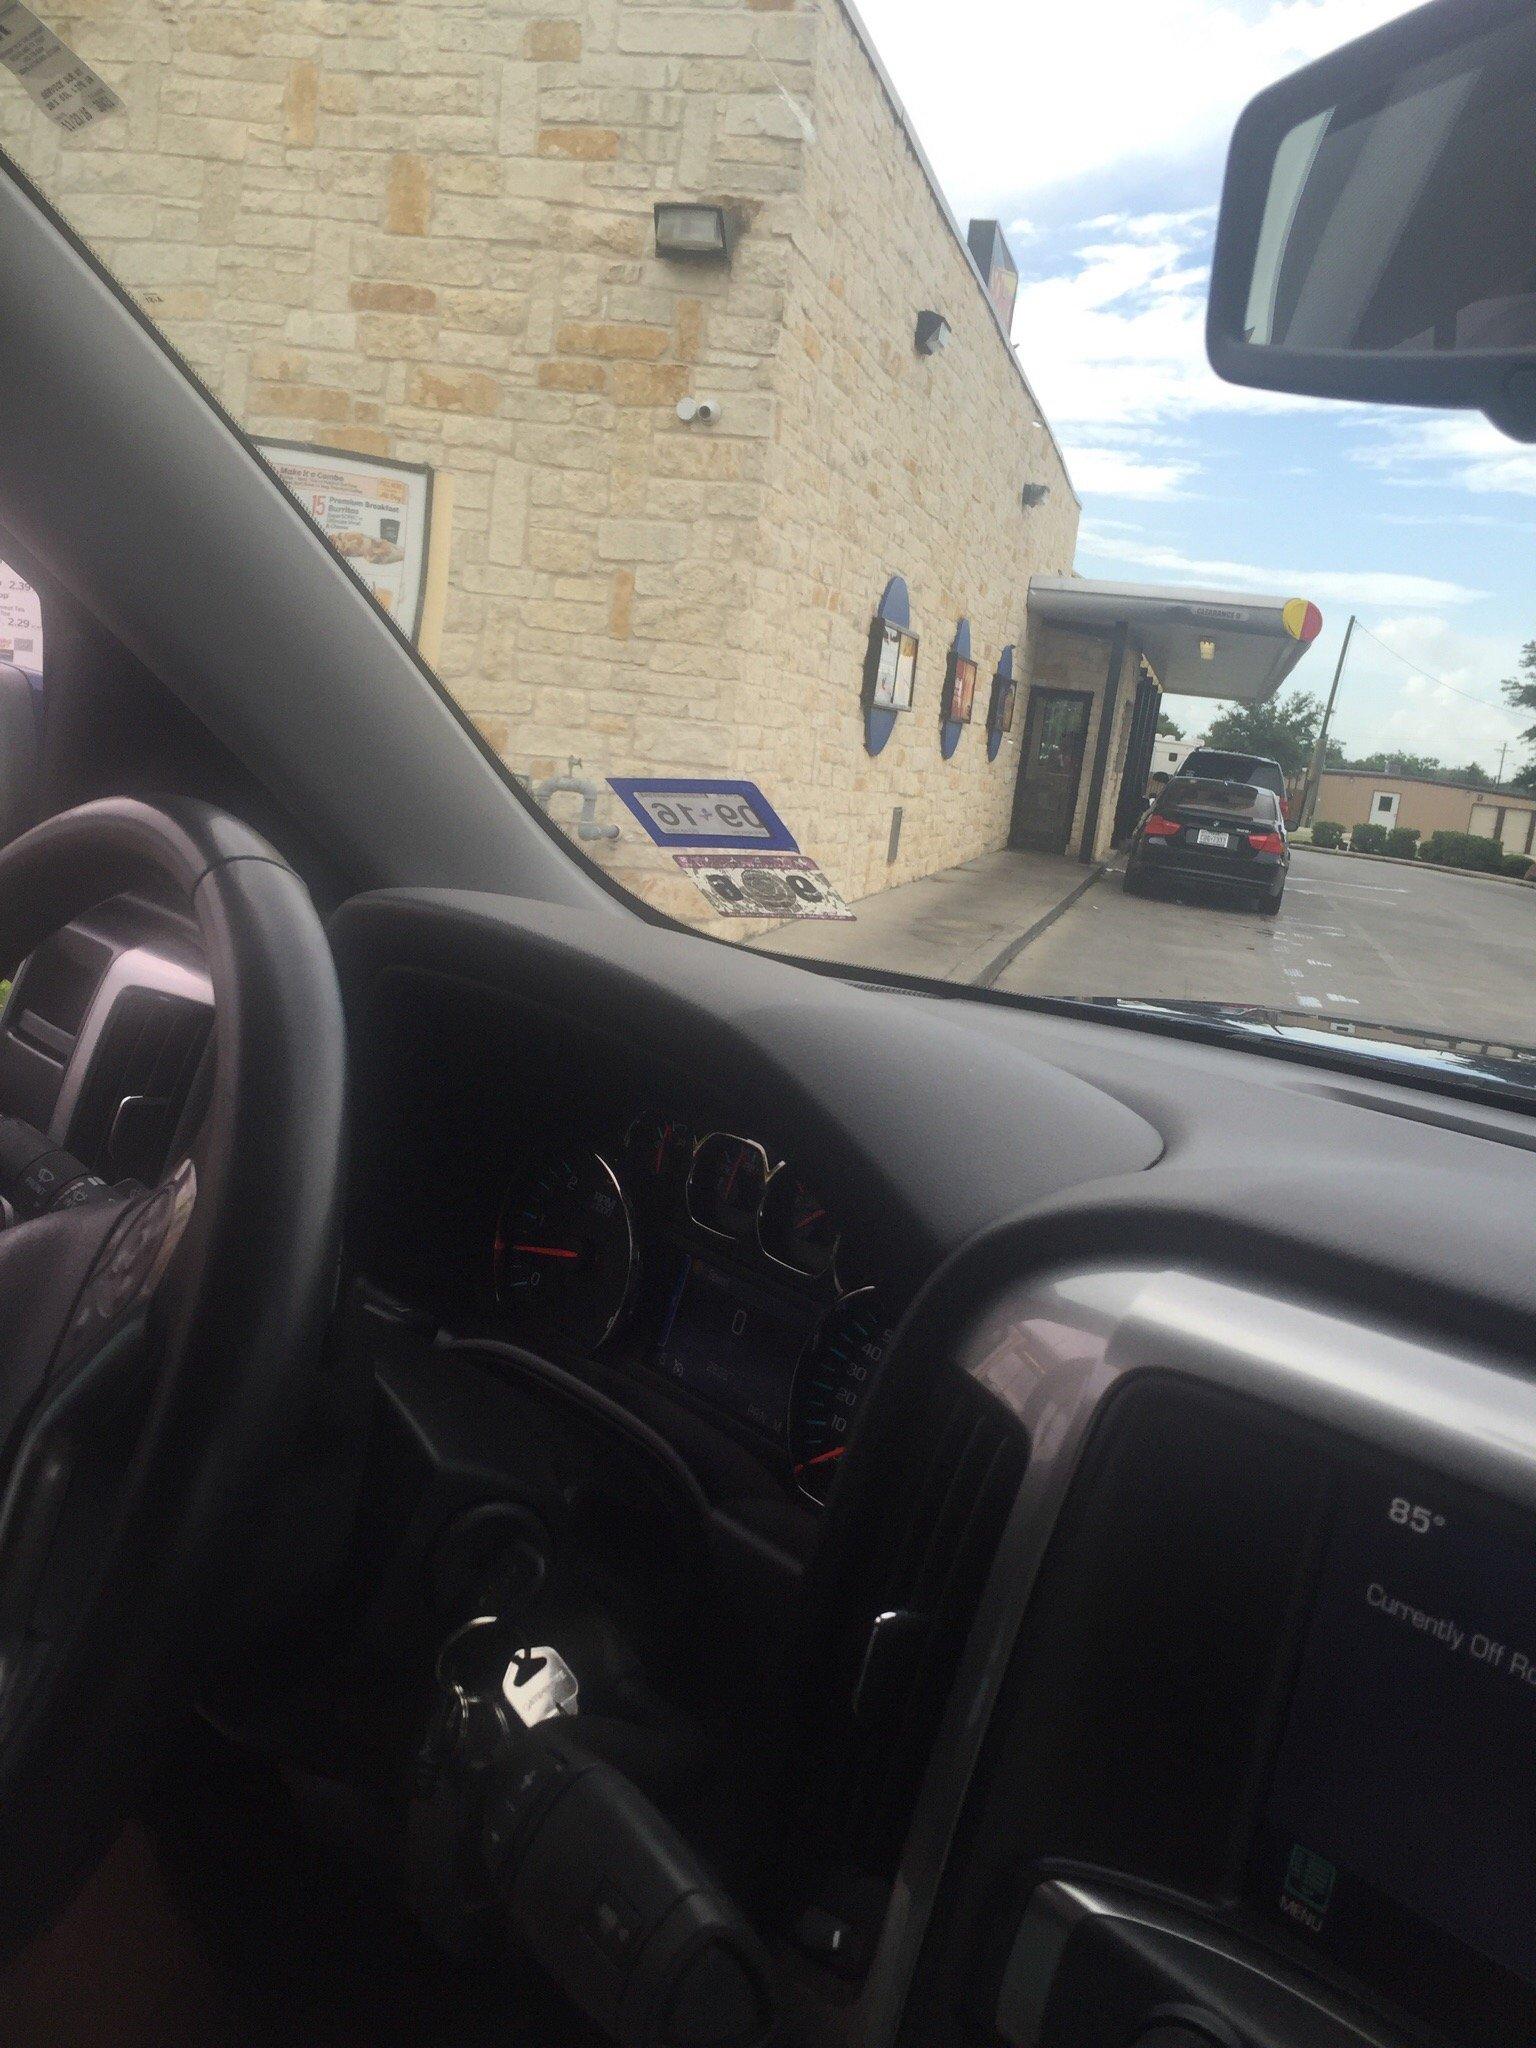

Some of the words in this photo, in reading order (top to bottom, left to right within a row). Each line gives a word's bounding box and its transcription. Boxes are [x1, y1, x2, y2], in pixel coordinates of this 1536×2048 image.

[328, 504, 359, 514] Burritos
[329, 496, 363, 507] Premium
[365, 501, 399, 513] Breakfast
[9, 580, 31, 591] 2.39
[8, 617, 30, 628] 2.29
[861, 1342, 882, 1361] 40
[846, 1362, 867, 1381] 30
[835, 1387, 857, 1407] 20
[831, 1413, 847, 1432] 10
[1388, 1496, 1446, 1534] 85°
[1366, 1582, 1465, 1651] Currently
[1471, 1633, 1506, 1666] Off
